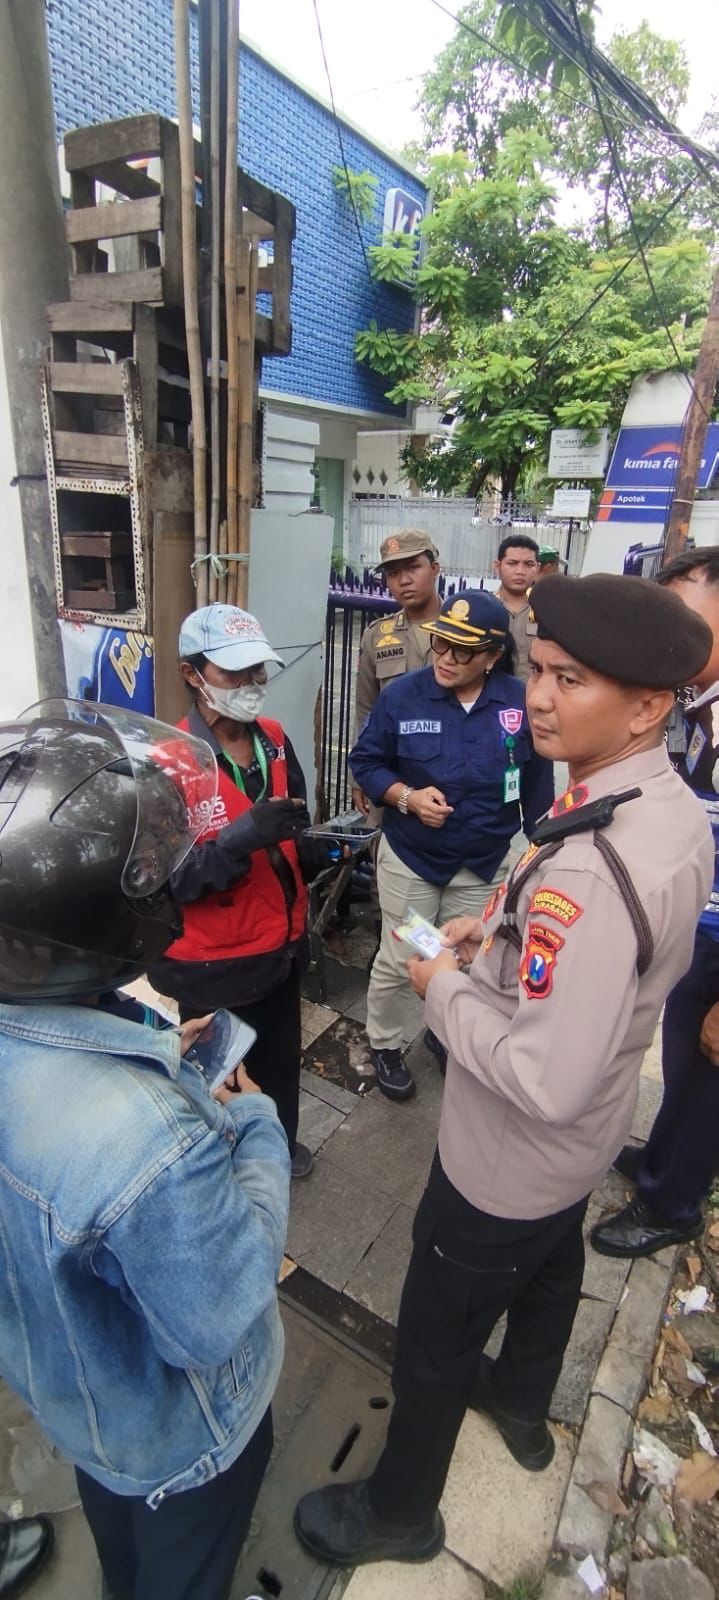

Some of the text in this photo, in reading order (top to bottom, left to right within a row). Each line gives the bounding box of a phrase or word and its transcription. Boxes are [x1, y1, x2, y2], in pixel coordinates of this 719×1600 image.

[623, 457, 660, 469] kimia
[617, 495, 646, 504] Apotek
[376, 647, 404, 660] ANANG
[402, 721, 439, 732] JEANE
